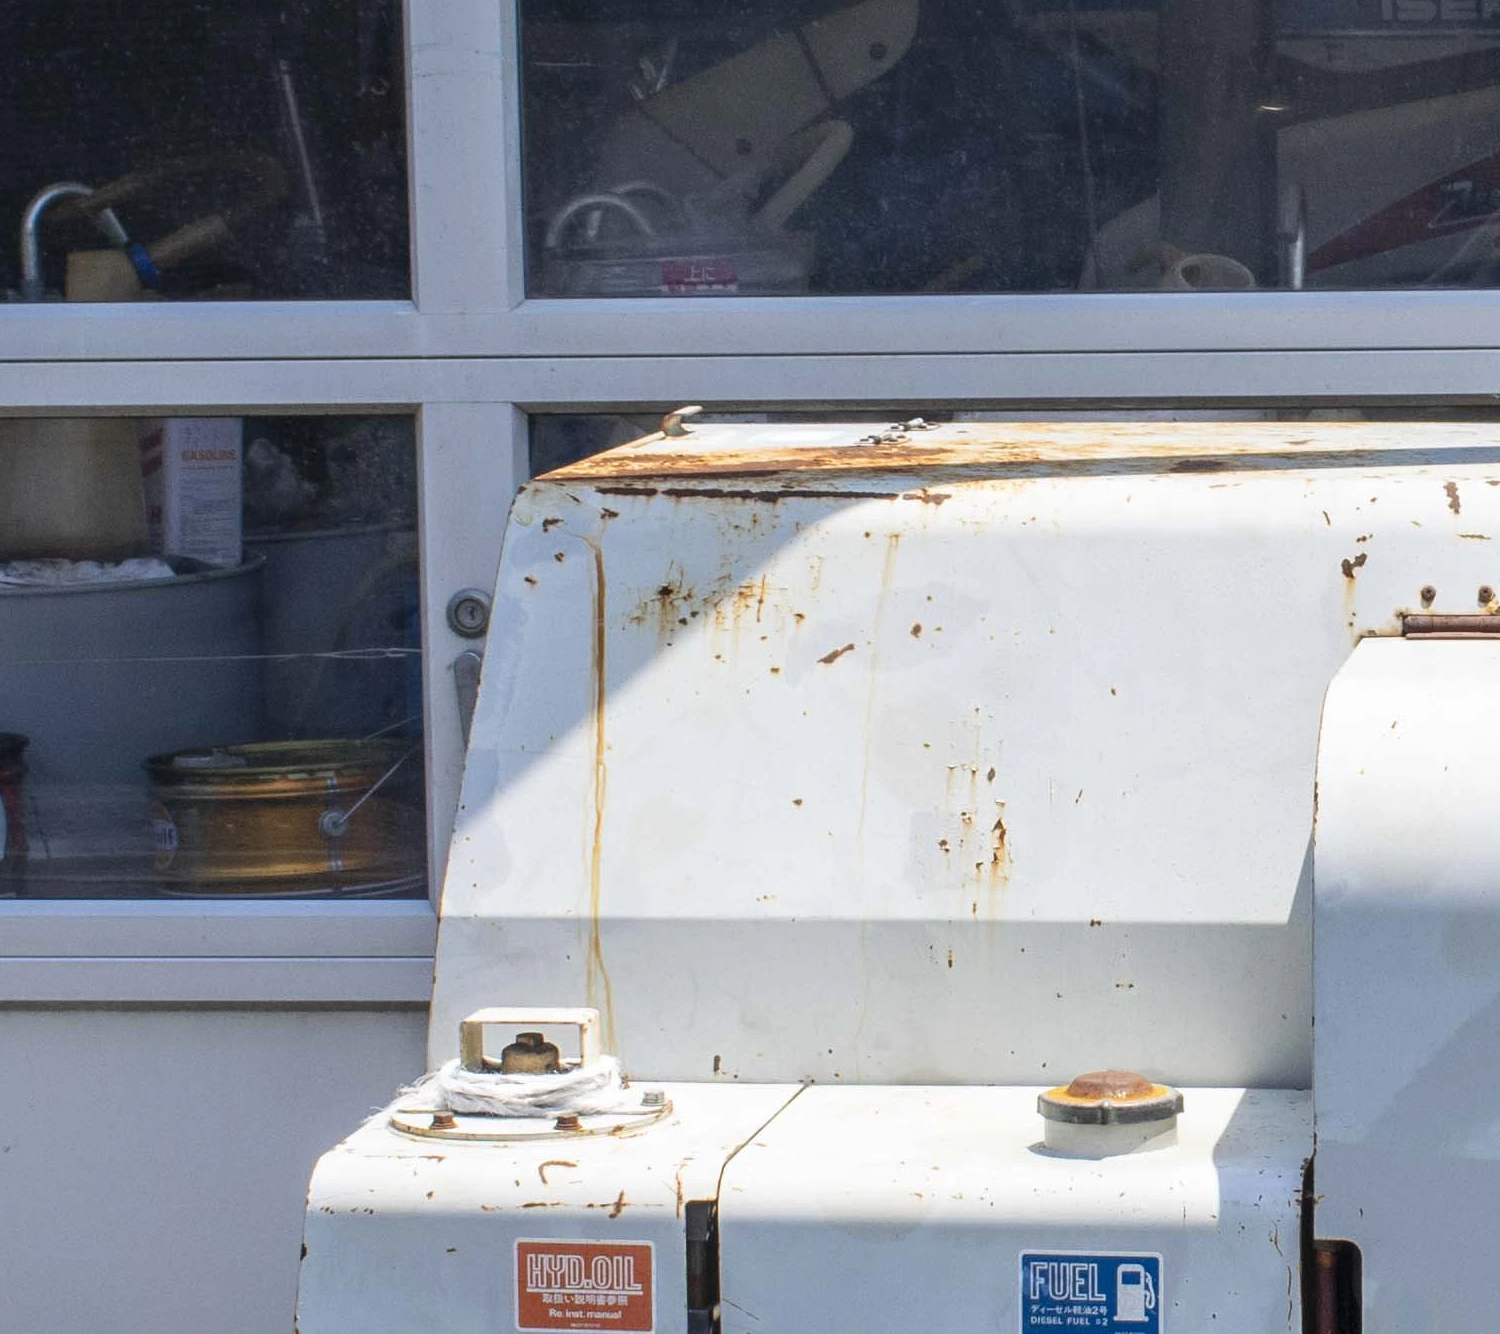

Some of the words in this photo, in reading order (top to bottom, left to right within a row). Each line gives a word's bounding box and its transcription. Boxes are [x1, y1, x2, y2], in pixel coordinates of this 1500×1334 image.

[527, 1253, 642, 1290] HYD.OIL
[1030, 1261, 1107, 1301] FUEL
[586, 1310, 622, 1320] manual
[1030, 1316, 1063, 1325] DIESEL
[1067, 1317, 1091, 1325] FUEL
